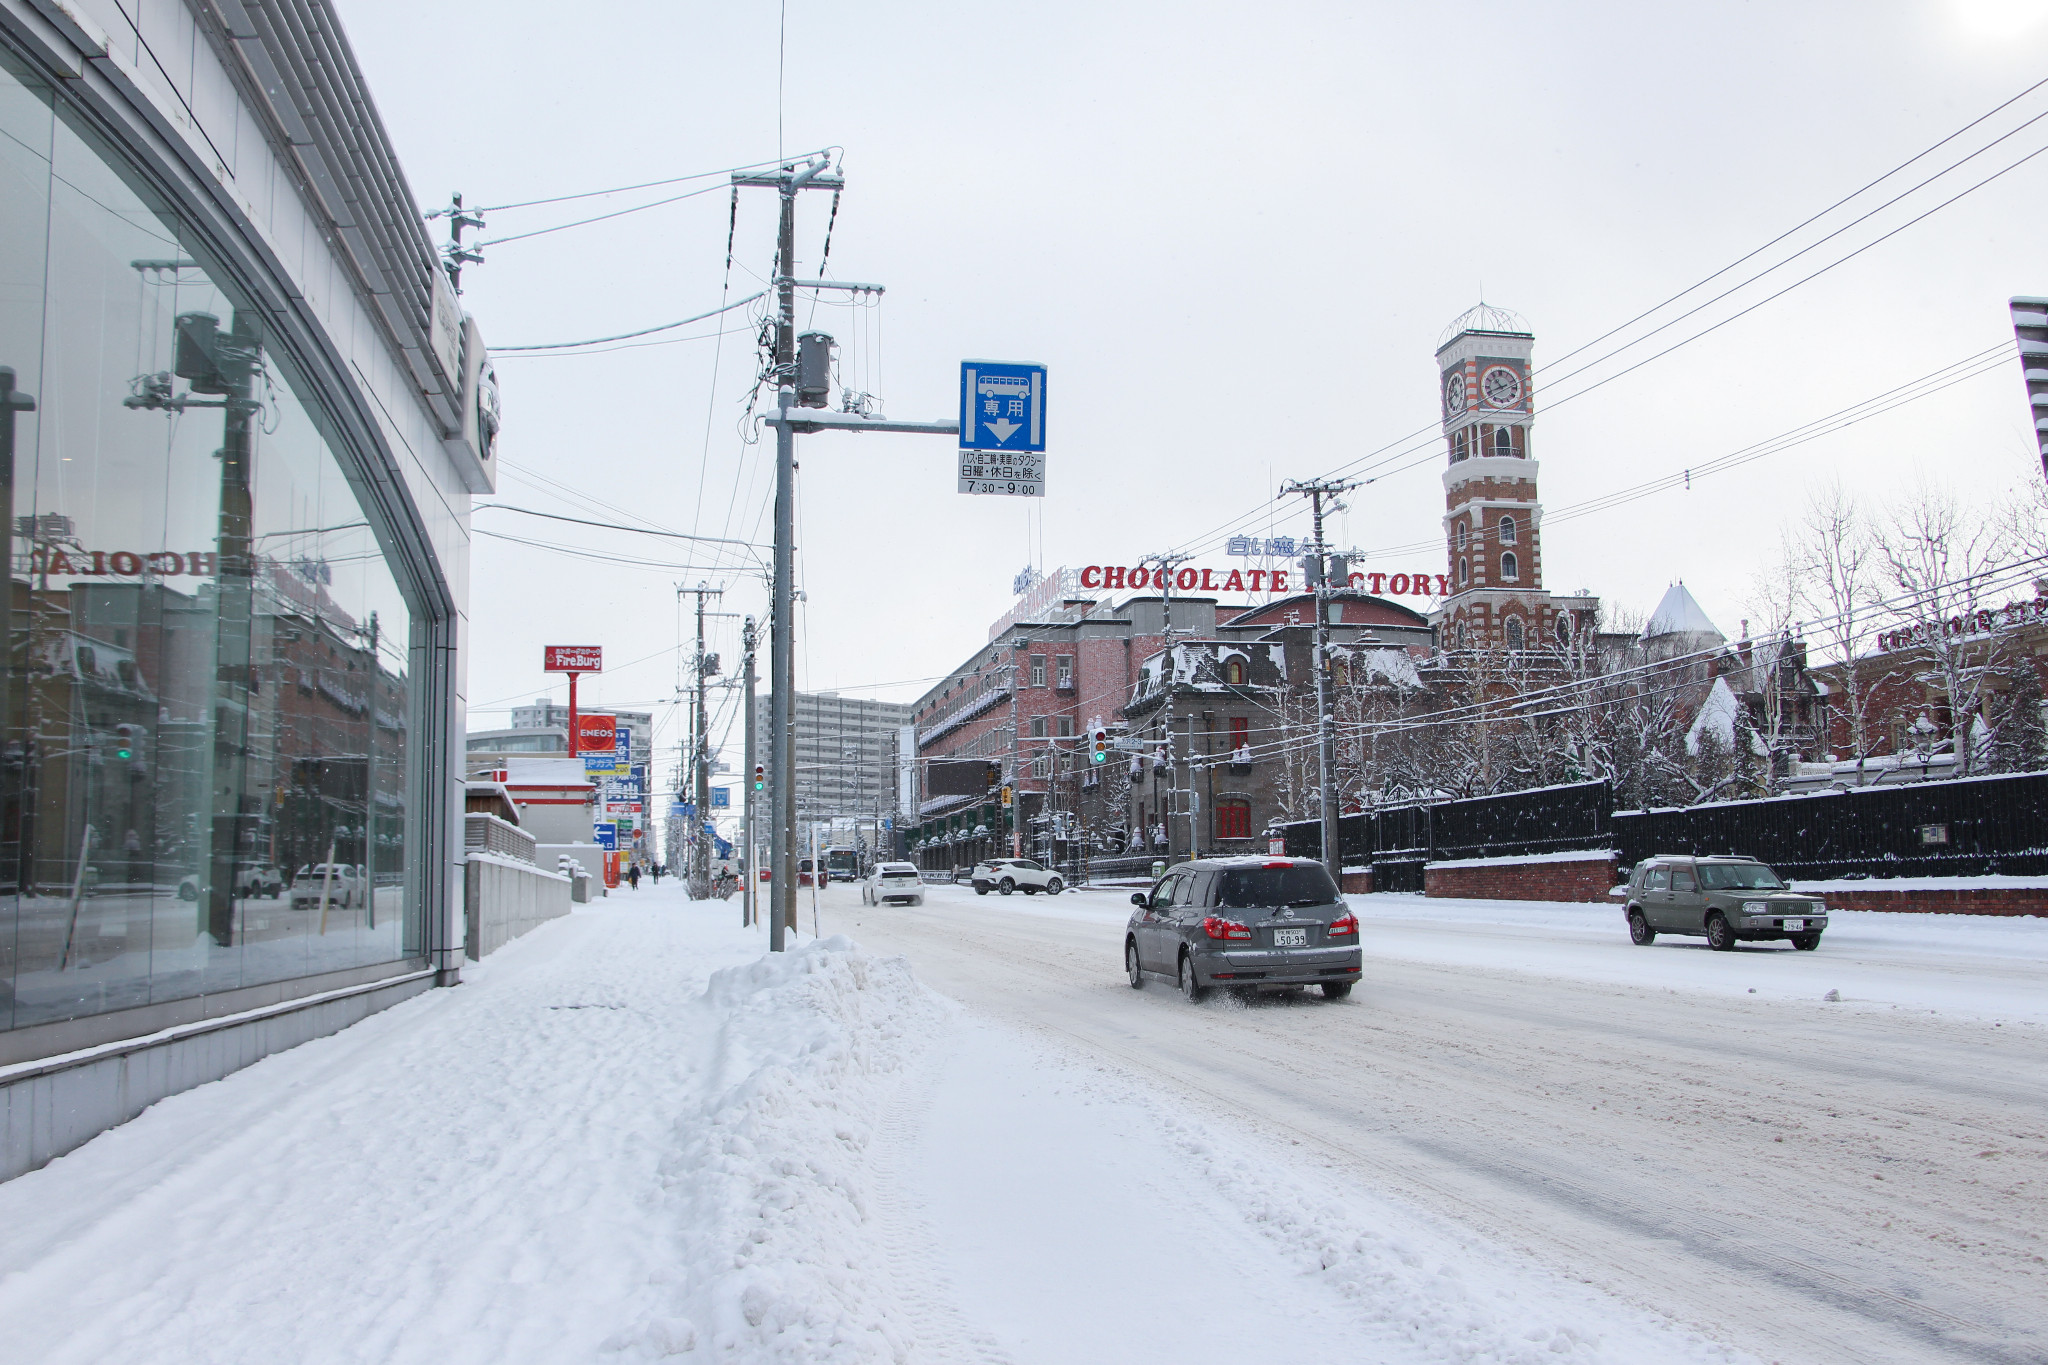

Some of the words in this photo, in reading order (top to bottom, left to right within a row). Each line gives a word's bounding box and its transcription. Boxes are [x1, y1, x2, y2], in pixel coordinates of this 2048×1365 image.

[984, 400, 1024, 417] 専用
[962, 465, 1041, 480] 日曜・休日を除く
[1081, 565, 1289, 593] CHOCOLATE
[1305, 572, 1451, 597] CTORY
[556, 654, 601, 669] FireBurg
[580, 729, 614, 737] ENEOS
[1280, 935, 1305, 945] 50-99
